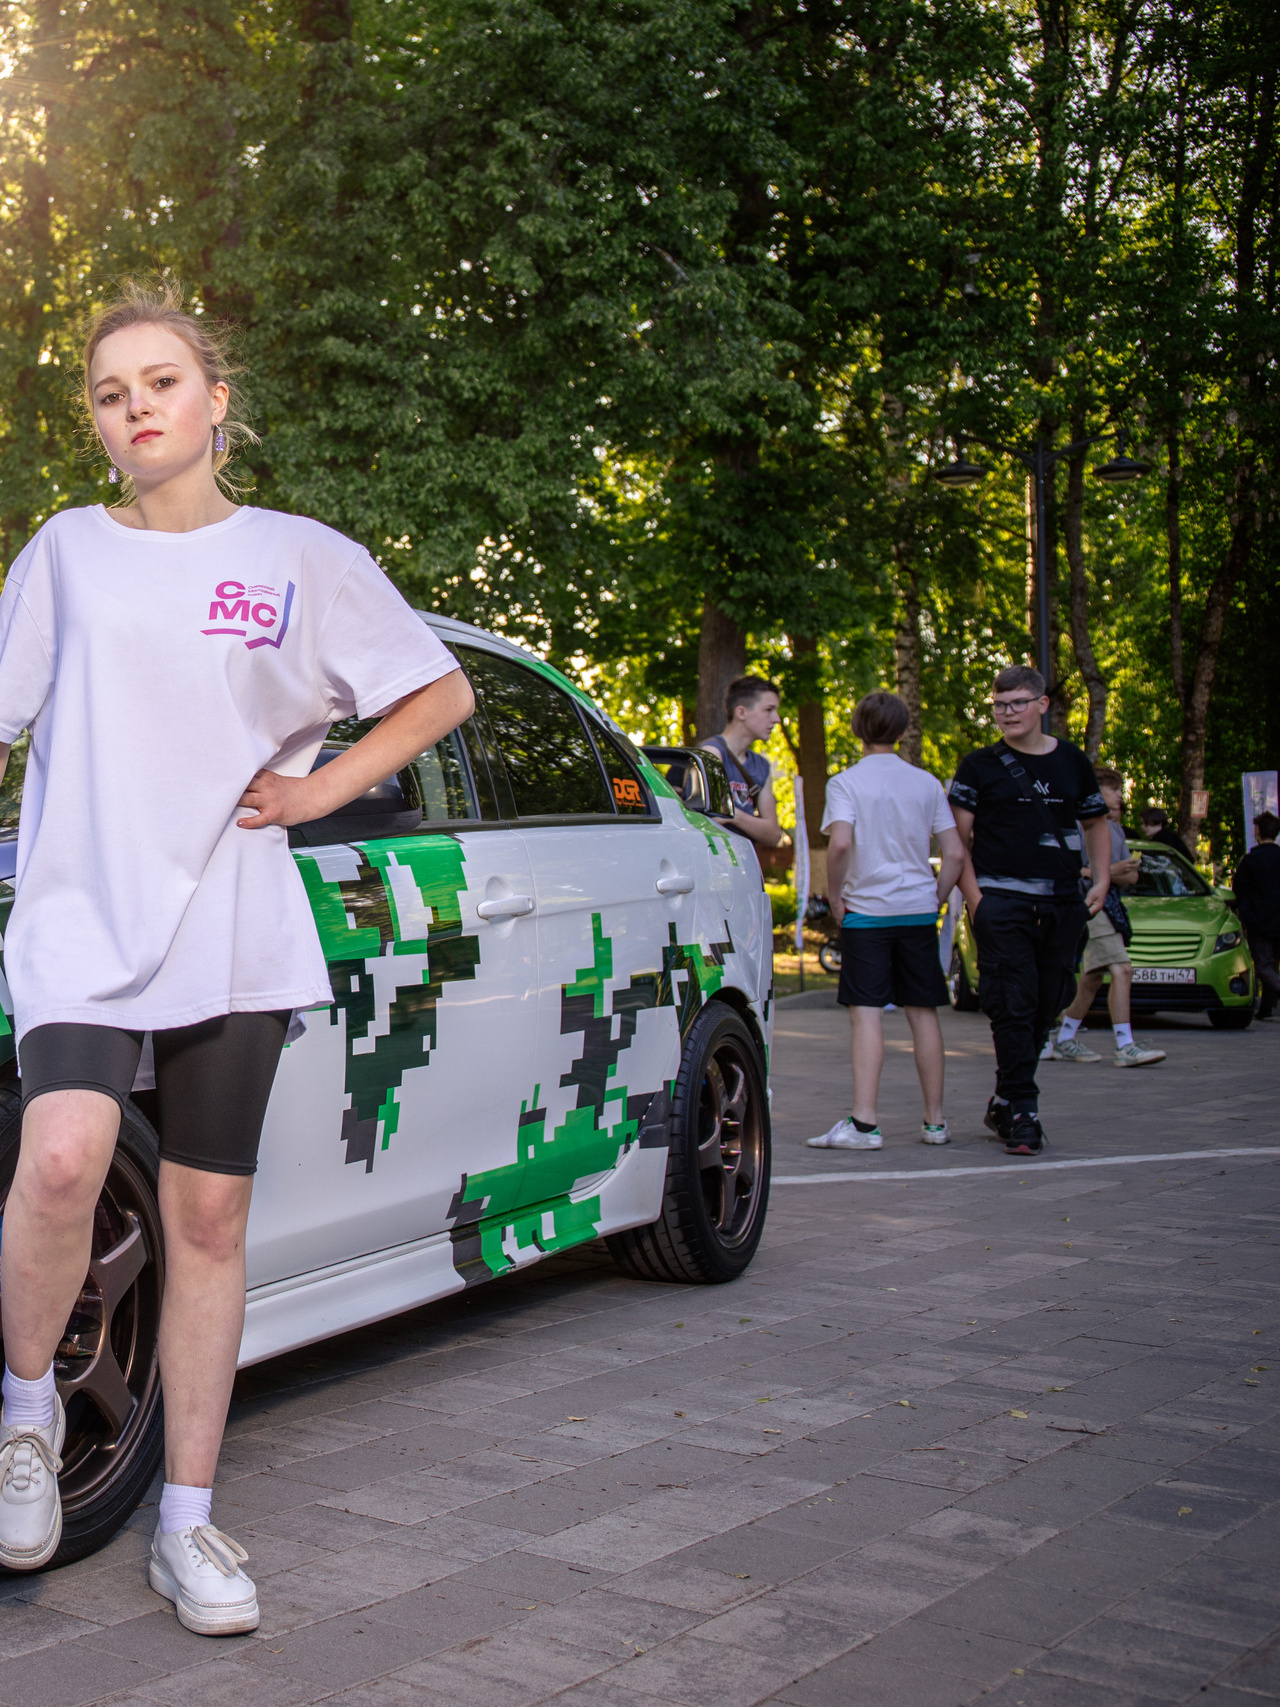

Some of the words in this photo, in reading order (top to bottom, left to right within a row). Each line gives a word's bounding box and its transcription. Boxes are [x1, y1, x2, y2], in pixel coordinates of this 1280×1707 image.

[612, 777, 641, 801] DGR
[1133, 969, 1175, 980] 588TH
[1178, 968, 1191, 978] 47
